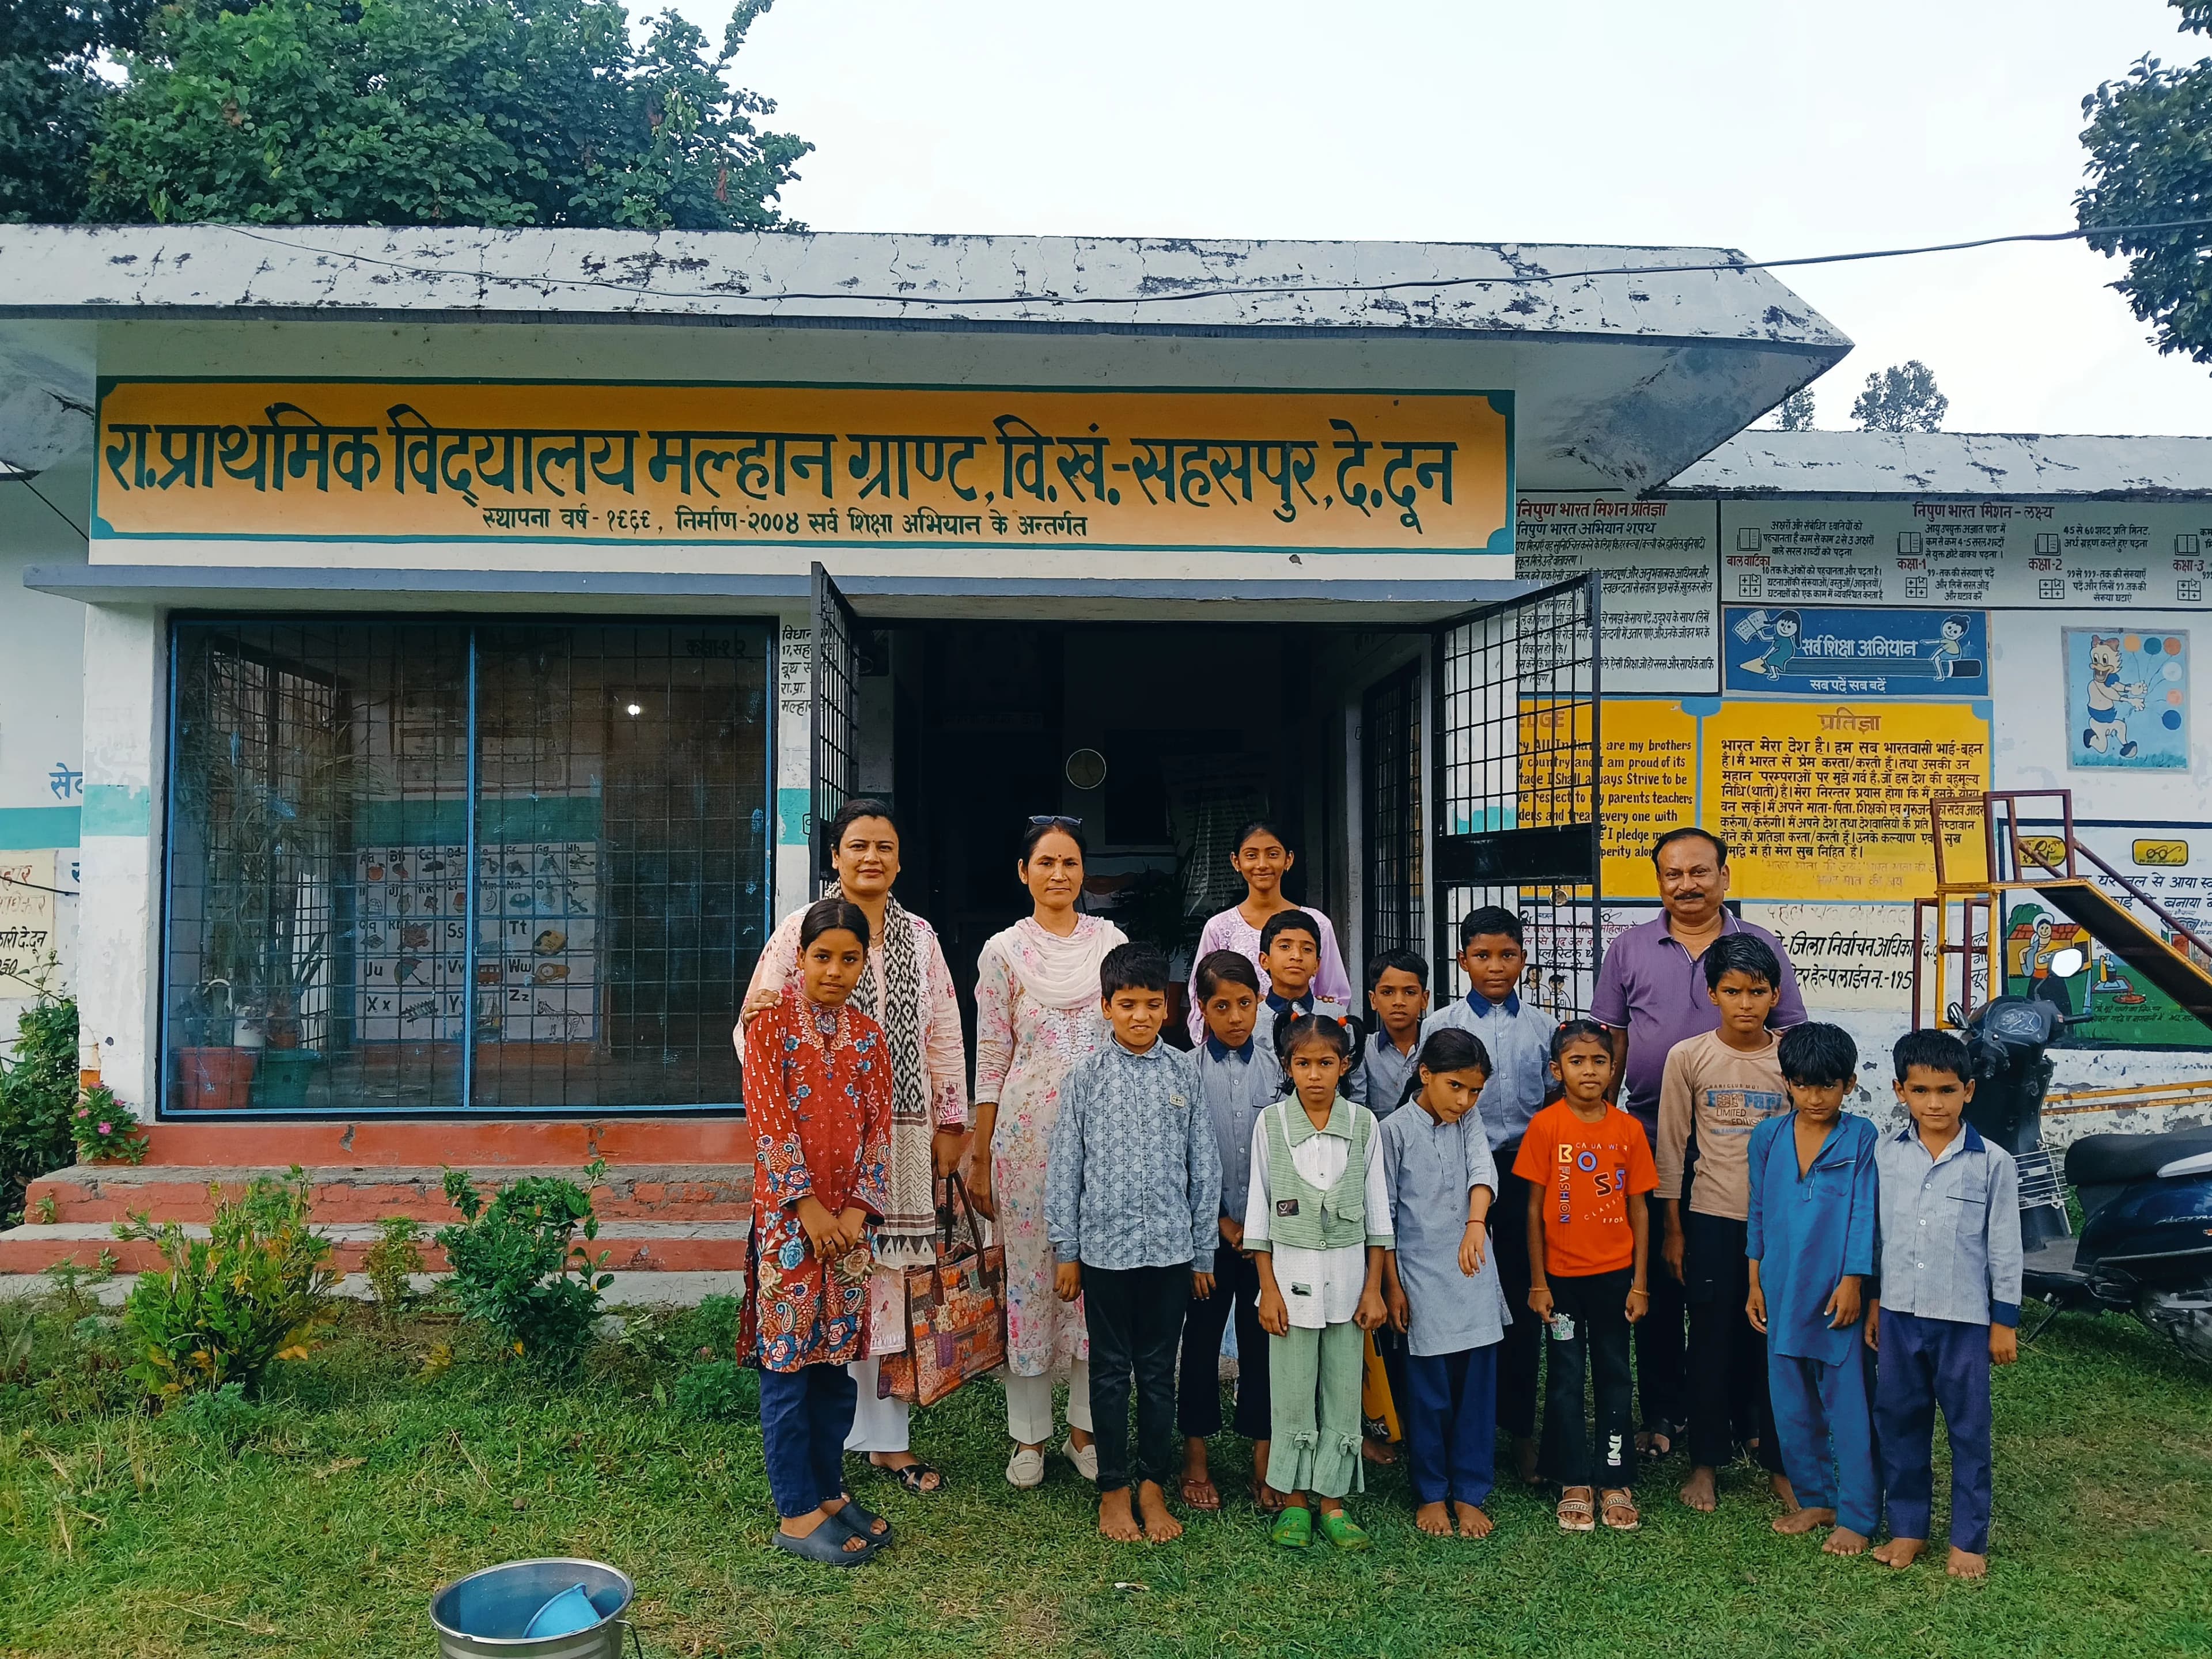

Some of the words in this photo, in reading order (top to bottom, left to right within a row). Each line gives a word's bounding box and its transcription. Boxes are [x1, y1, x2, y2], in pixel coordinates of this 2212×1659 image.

[647, 430, 838, 501] मल्हान
[1559, 502, 1589, 517] भारत
[1592, 501, 1633, 517] मिशन
[1630, 501, 1668, 520] प्रतिज्ञा
[1912, 501, 1946, 522] निपुण
[1948, 504, 1976, 518] भारत
[1980, 502, 2013, 518] मिशन
[2024, 506, 2055, 521] लक्ष्य
[483, 507, 551, 529] स्थापना
[807, 508, 839, 533] सर्व
[847, 507, 892, 538] शिक्षा
[903, 506, 981, 535] अभियान
[988, 509, 1009, 535] के
[1017, 510, 1088, 537] अन्तर्गत
[1516, 521, 1548, 539] निपुण
[1550, 522, 1578, 536] भारत
[1578, 520, 1625, 535] अभियान
[2063, 526, 2075, 535] 45
[2075, 525, 2083, 535] से
[1802, 634, 1824, 657] सर्व
[1823, 634, 1856, 658] शिक्षा
[1857, 635, 1918, 658] अभियान
[1810, 679, 1831, 692] सब
[1848, 680, 1868, 692] सब
[1816, 706, 1881, 734] प्रतिज्ञा
[1606, 741, 1625, 751] are
[1629, 741, 1644, 753] my
[1649, 739, 1692, 751] brothers
[1721, 740, 1755, 752] भारत
[1760, 736, 1783, 753] मेरा
[1787, 736, 1811, 753] देश
[1834, 741, 1854, 755] हम
[1883, 740, 1933, 756] भारतवासी
[1607, 758, 1624, 768] am
[1628, 756, 1660, 770] proud
[1661, 756, 1672, 768] of
[1673, 756, 1685, 768] its
[1749, 756, 1778, 768] भारत
[1781, 753, 1793, 768] से
[1797, 754, 1817, 768] प्रेम
[1921, 756, 1952, 770] उसकी
[1955, 760, 1970, 770] उन
[1627, 772, 1660, 785] Strive
[1662, 773, 1672, 785] to
[1675, 773, 1687, 785] be
[1721, 770, 1753, 785] महान
[1815, 772, 1830, 783] पर
[1832, 769, 1850, 785] मुझे
[1852, 769, 1867, 783] गर्व
[1895, 772, 1910, 785] इस
[1911, 770, 1927, 785] देश
[1929, 771, 1942, 785] की
[1608, 791, 1650, 806] parents
[1652, 791, 1693, 805] teachers
[1794, 783, 1812, 799] मेरा
[1816, 783, 1851, 799] निरन्तर
[1854, 787, 1882, 800] प्रयास
[1884, 785, 1906, 801] होगा
[1907, 785, 1919, 800] कि
[1778, 800, 1804, 814] अपने
[1600, 810, 1628, 824] every
[1632, 811, 1650, 821] one
[1654, 809, 1678, 821] with
[1796, 816, 1821, 829] अपने
[1823, 816, 1838, 829] देश
[1839, 818, 1858, 829] तथा
[1913, 817, 1929, 830] प्रति
[1616, 827, 1649, 843] pledge
[1740, 829, 1753, 842] की
[1756, 829, 1785, 843] प्रतिज्ञा
[1855, 830, 1879, 844] उनके
[1881, 833, 1916, 844] कल्याण
[1749, 843, 1759, 857] में
[1761, 843, 1772, 858] ही
[1774, 843, 1793, 857] मेरा
[1817, 844, 1846, 859] निहित
[2151, 872, 2165, 887] से
[2169, 877, 2198, 889] आया
[2164, 897, 2202, 908] बनाया
[447, 922, 464, 939] Ss
[509, 920, 528, 935] Tt
[1716, 1108, 1747, 1117] LIMITED
